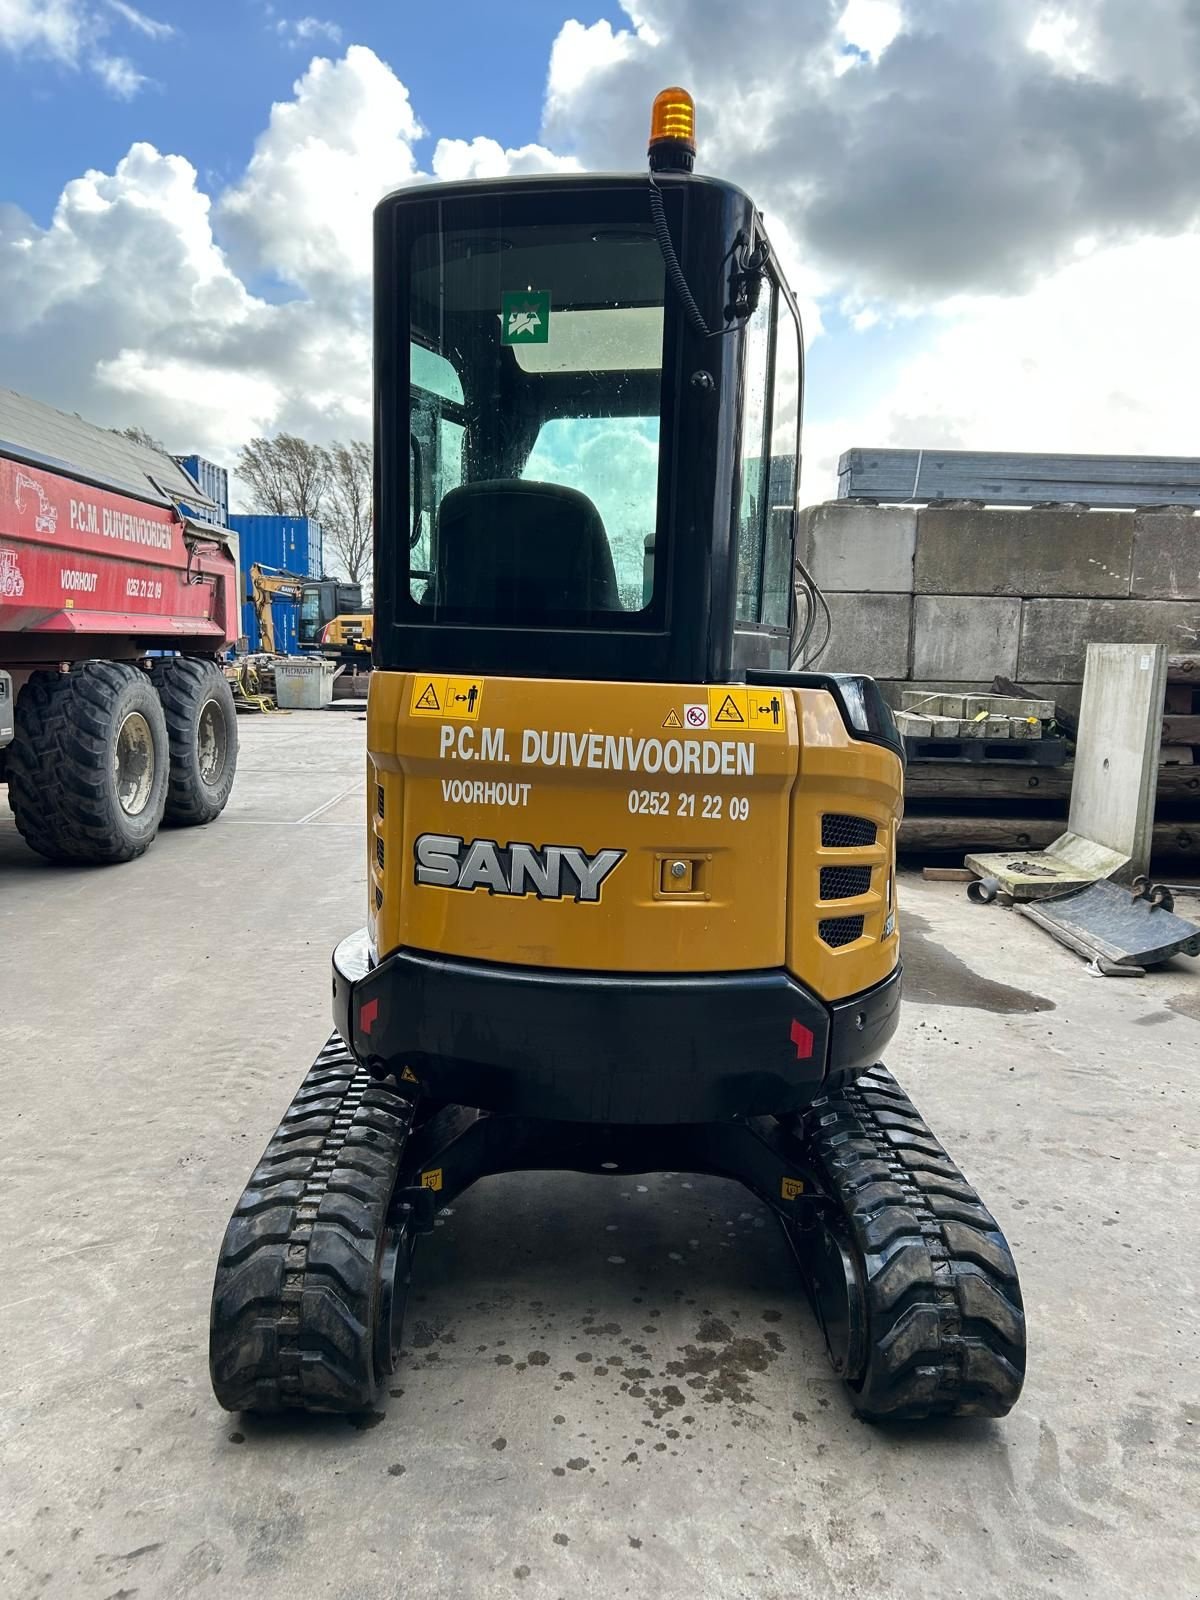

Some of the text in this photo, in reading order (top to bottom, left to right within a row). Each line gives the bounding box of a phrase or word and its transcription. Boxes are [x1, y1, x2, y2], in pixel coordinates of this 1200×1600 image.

[70, 499, 172, 551] P.C.M. DUIVENVOORDEN
[61, 569, 98, 592] VOORHOUT
[126, 578, 162, 599] 0252 21 22 09
[439, 725, 755, 776] P.C.M. DUIVENVOORDEN
[441, 779, 532, 806] VOORHOUT
[628, 789, 750, 821] 0252 21 22 09
[414, 832, 628, 904] SANY
